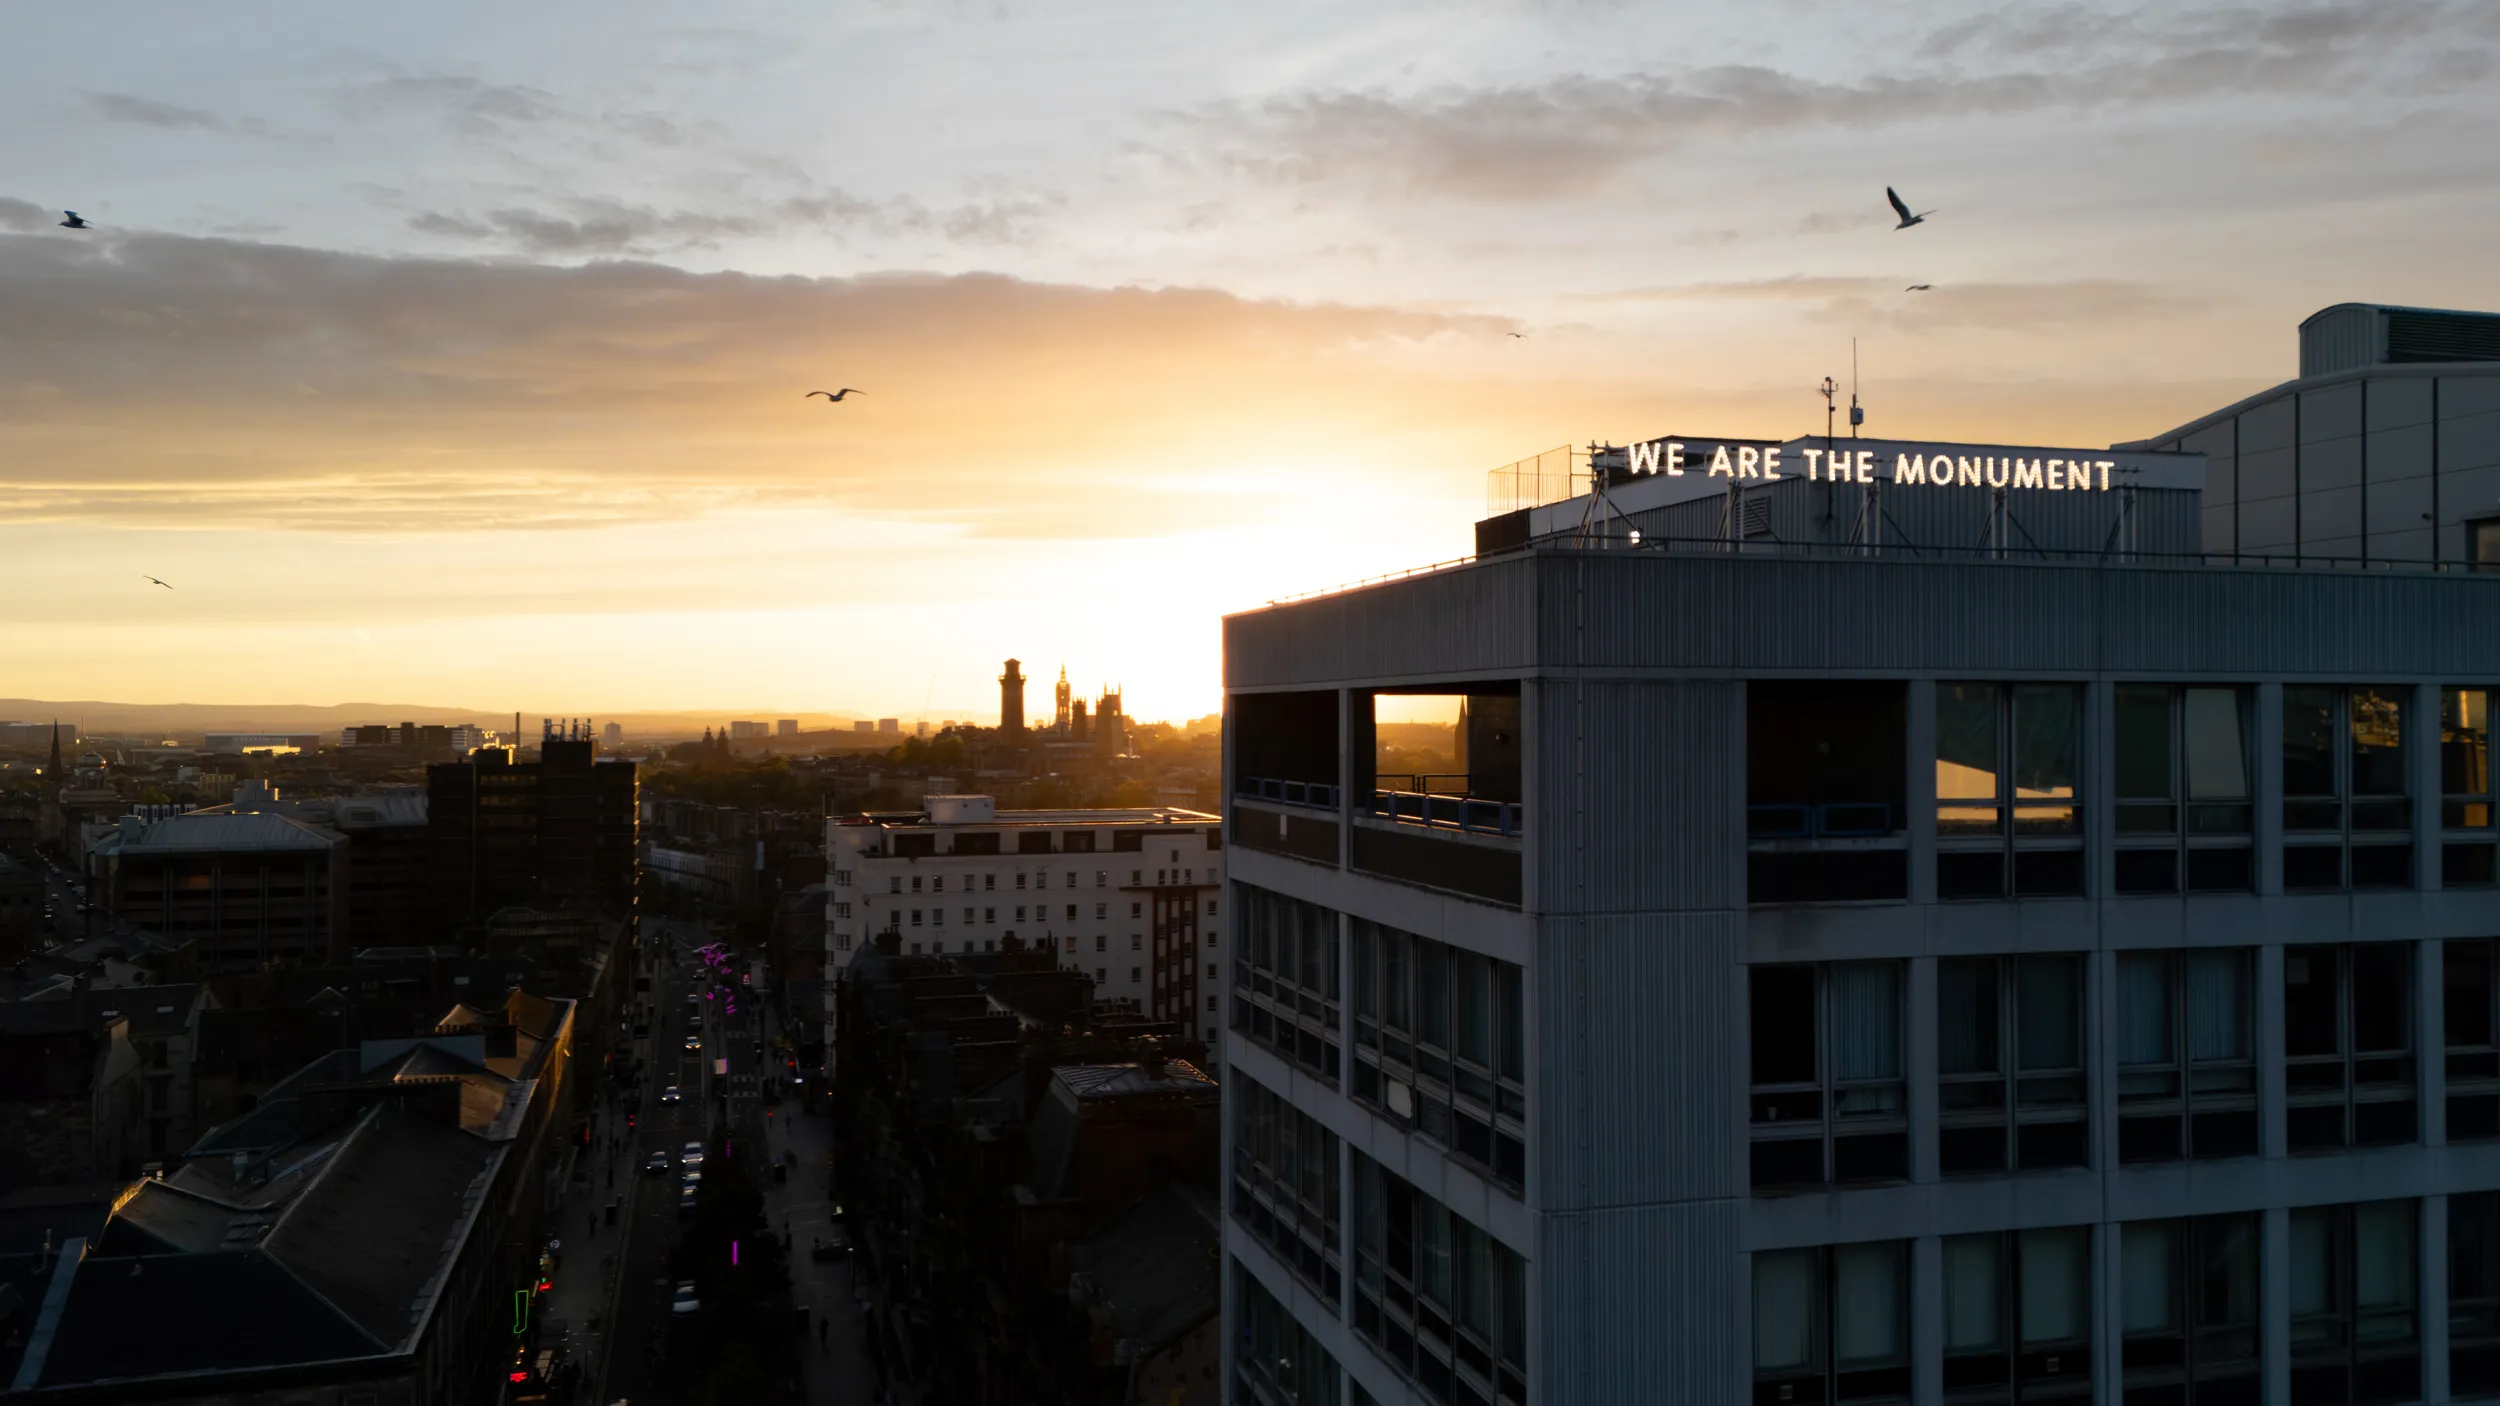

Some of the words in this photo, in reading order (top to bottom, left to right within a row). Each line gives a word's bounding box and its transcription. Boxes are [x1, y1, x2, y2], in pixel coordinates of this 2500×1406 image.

[1627, 442, 1685, 476] WE
[1707, 445, 1782, 480] ARE
[1803, 449, 1875, 483] THE
[1894, 453, 2115, 491] MONUMENT
